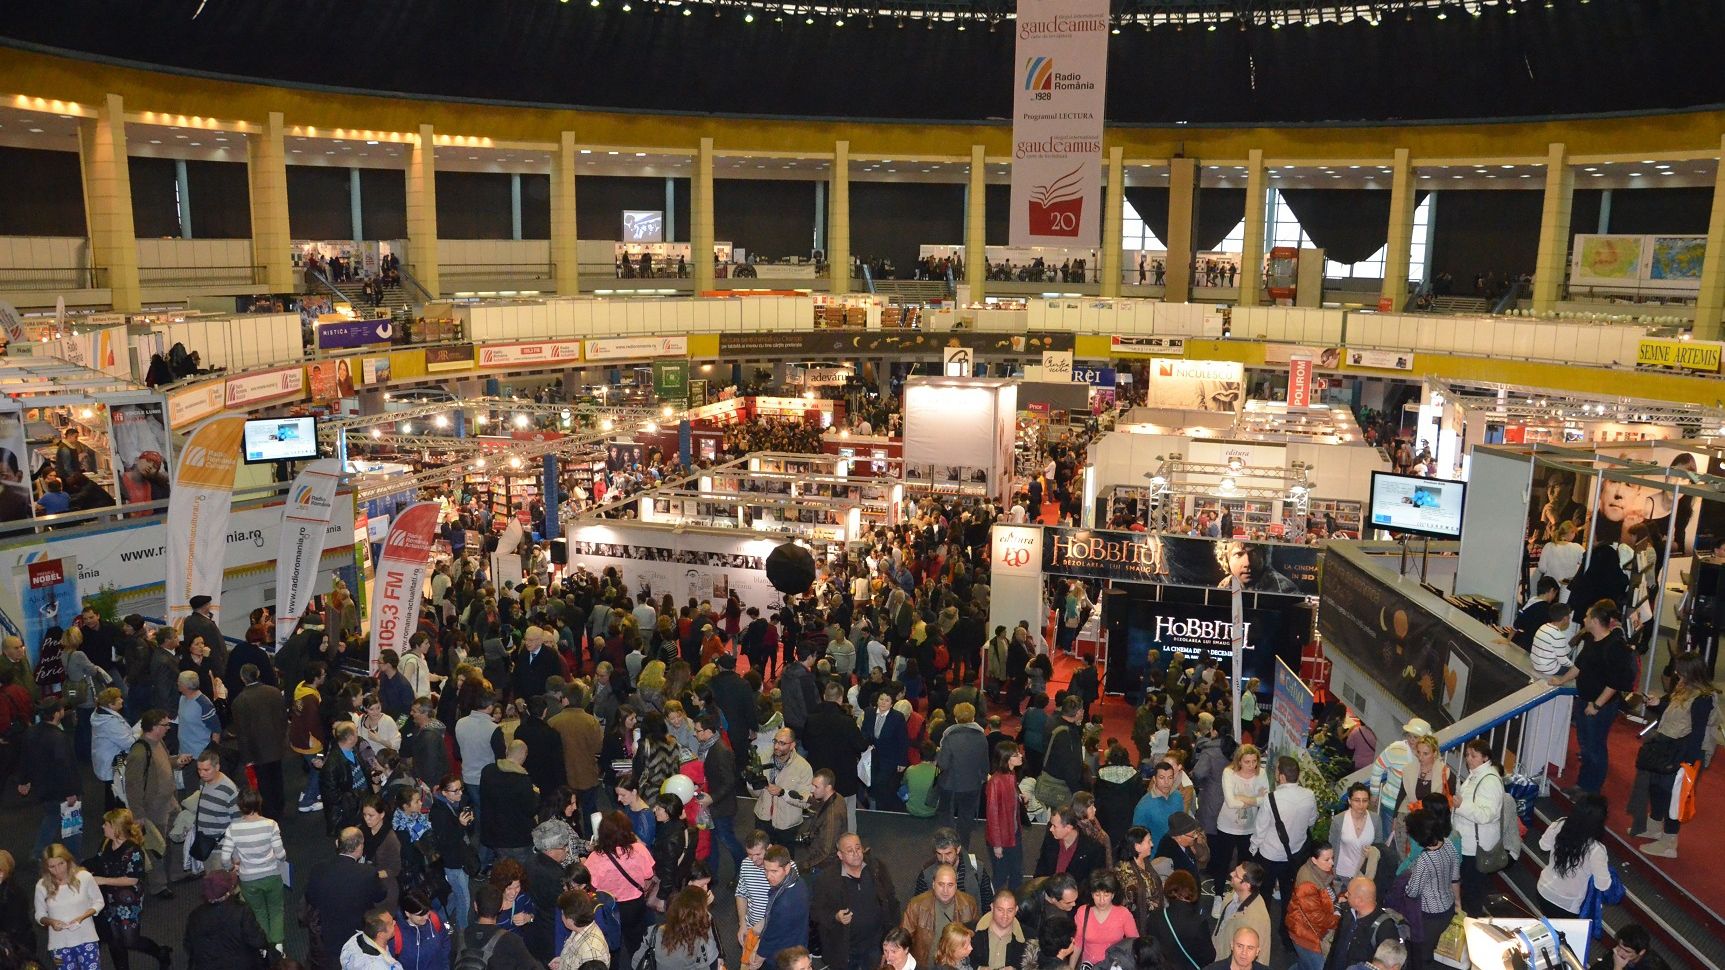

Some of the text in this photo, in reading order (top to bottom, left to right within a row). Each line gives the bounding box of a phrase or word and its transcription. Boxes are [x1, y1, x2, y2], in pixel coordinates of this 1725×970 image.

[1020, 15, 1106, 40] gaudeamus
[1054, 73, 1081, 81] Radio
[1054, 82, 1095, 90] România
[1035, 92, 1052, 100] 1928
[1023, 113, 1058, 121] Programul
[1015, 136, 1101, 159] gaudeamus
[1050, 212, 1076, 230] 20
[1640, 344, 1717, 366] SEMNE ARTEMIS
[1176, 368, 1233, 380] NICULESCU
[1294, 361, 1306, 406] POLIROM
[226, 530, 262, 544] nia.ro
[288, 526, 306, 614] www.radioromania.ro
[1126, 565, 1152, 573] SMAUG
[33, 574, 61, 584] NOBEL
[378, 571, 404, 649] 105,3 FM
[1154, 615, 1255, 650] HOBBITL
